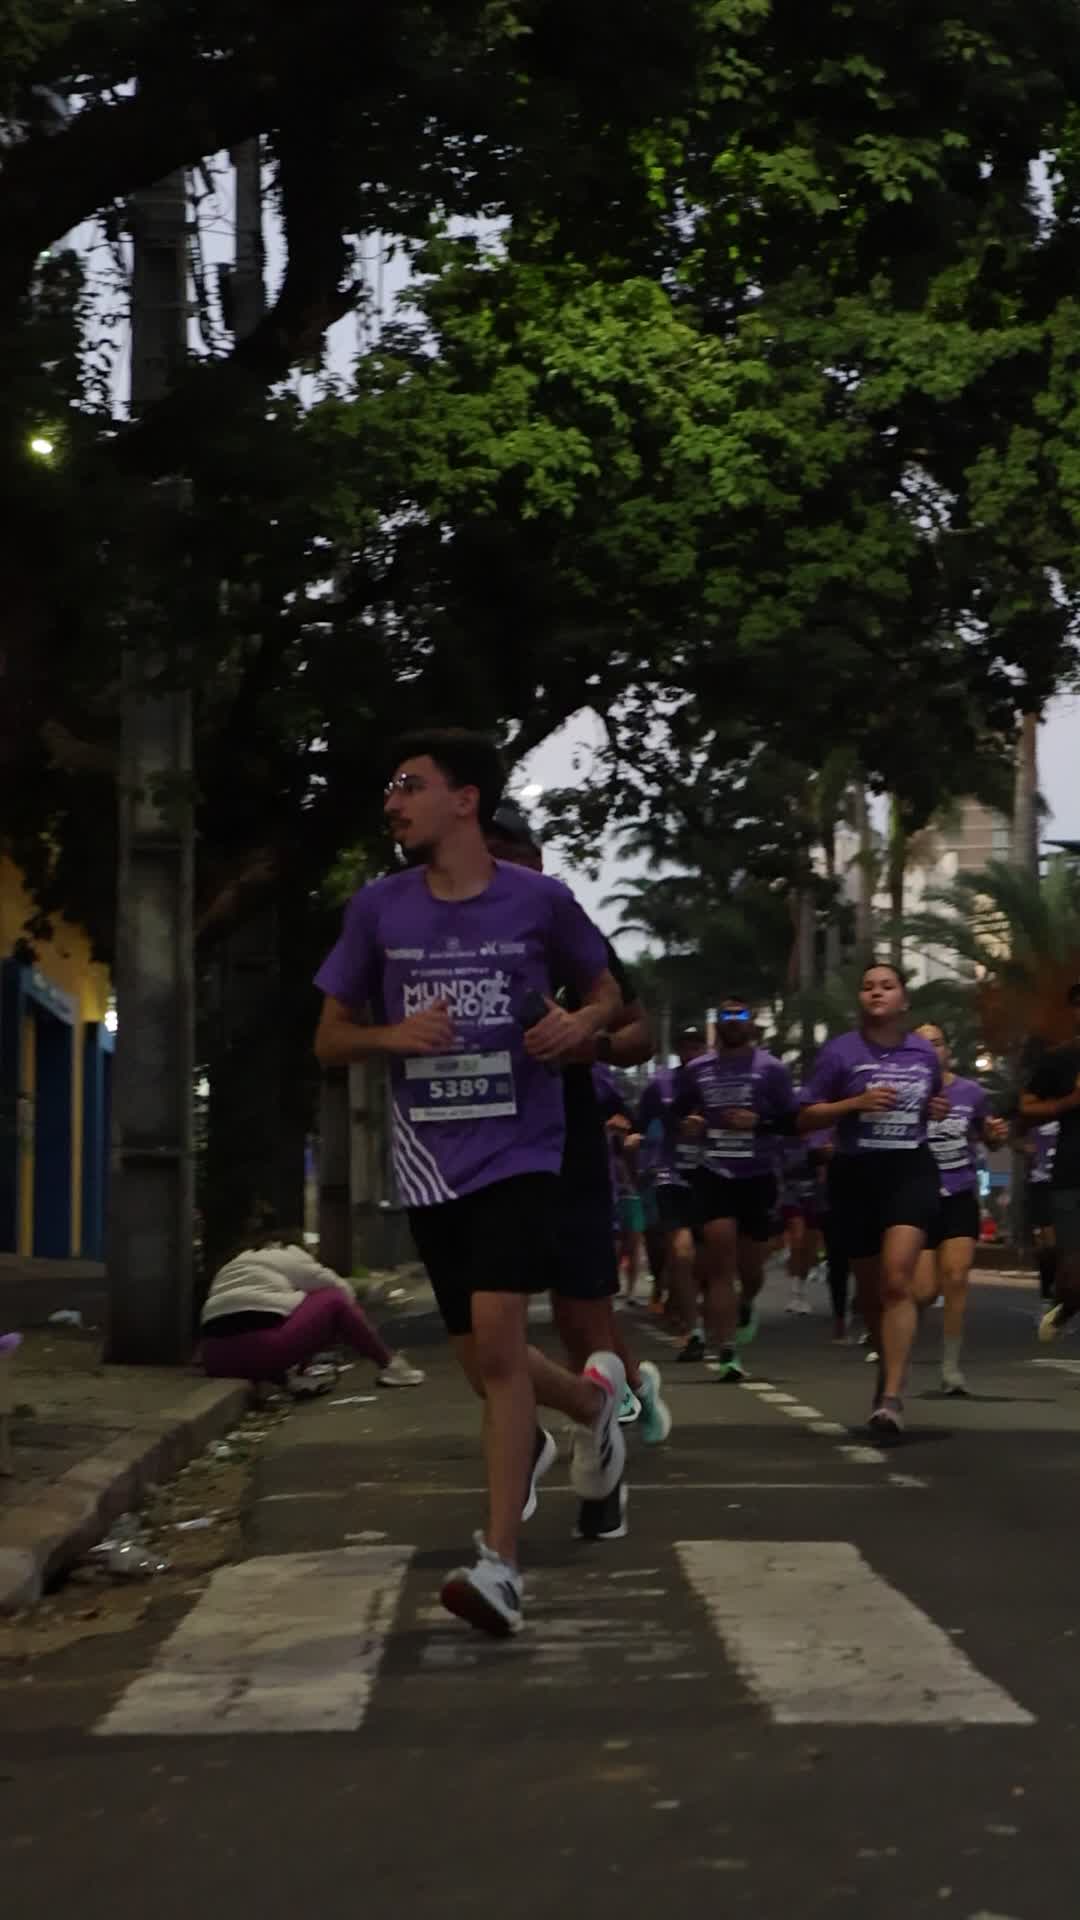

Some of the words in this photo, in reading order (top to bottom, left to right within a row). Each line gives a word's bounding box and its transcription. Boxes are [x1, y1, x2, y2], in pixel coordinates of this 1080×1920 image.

[402, 979, 490, 1002] MUNDO
[403, 997, 497, 1017] MHOR
[429, 1077, 490, 1099] 5389
